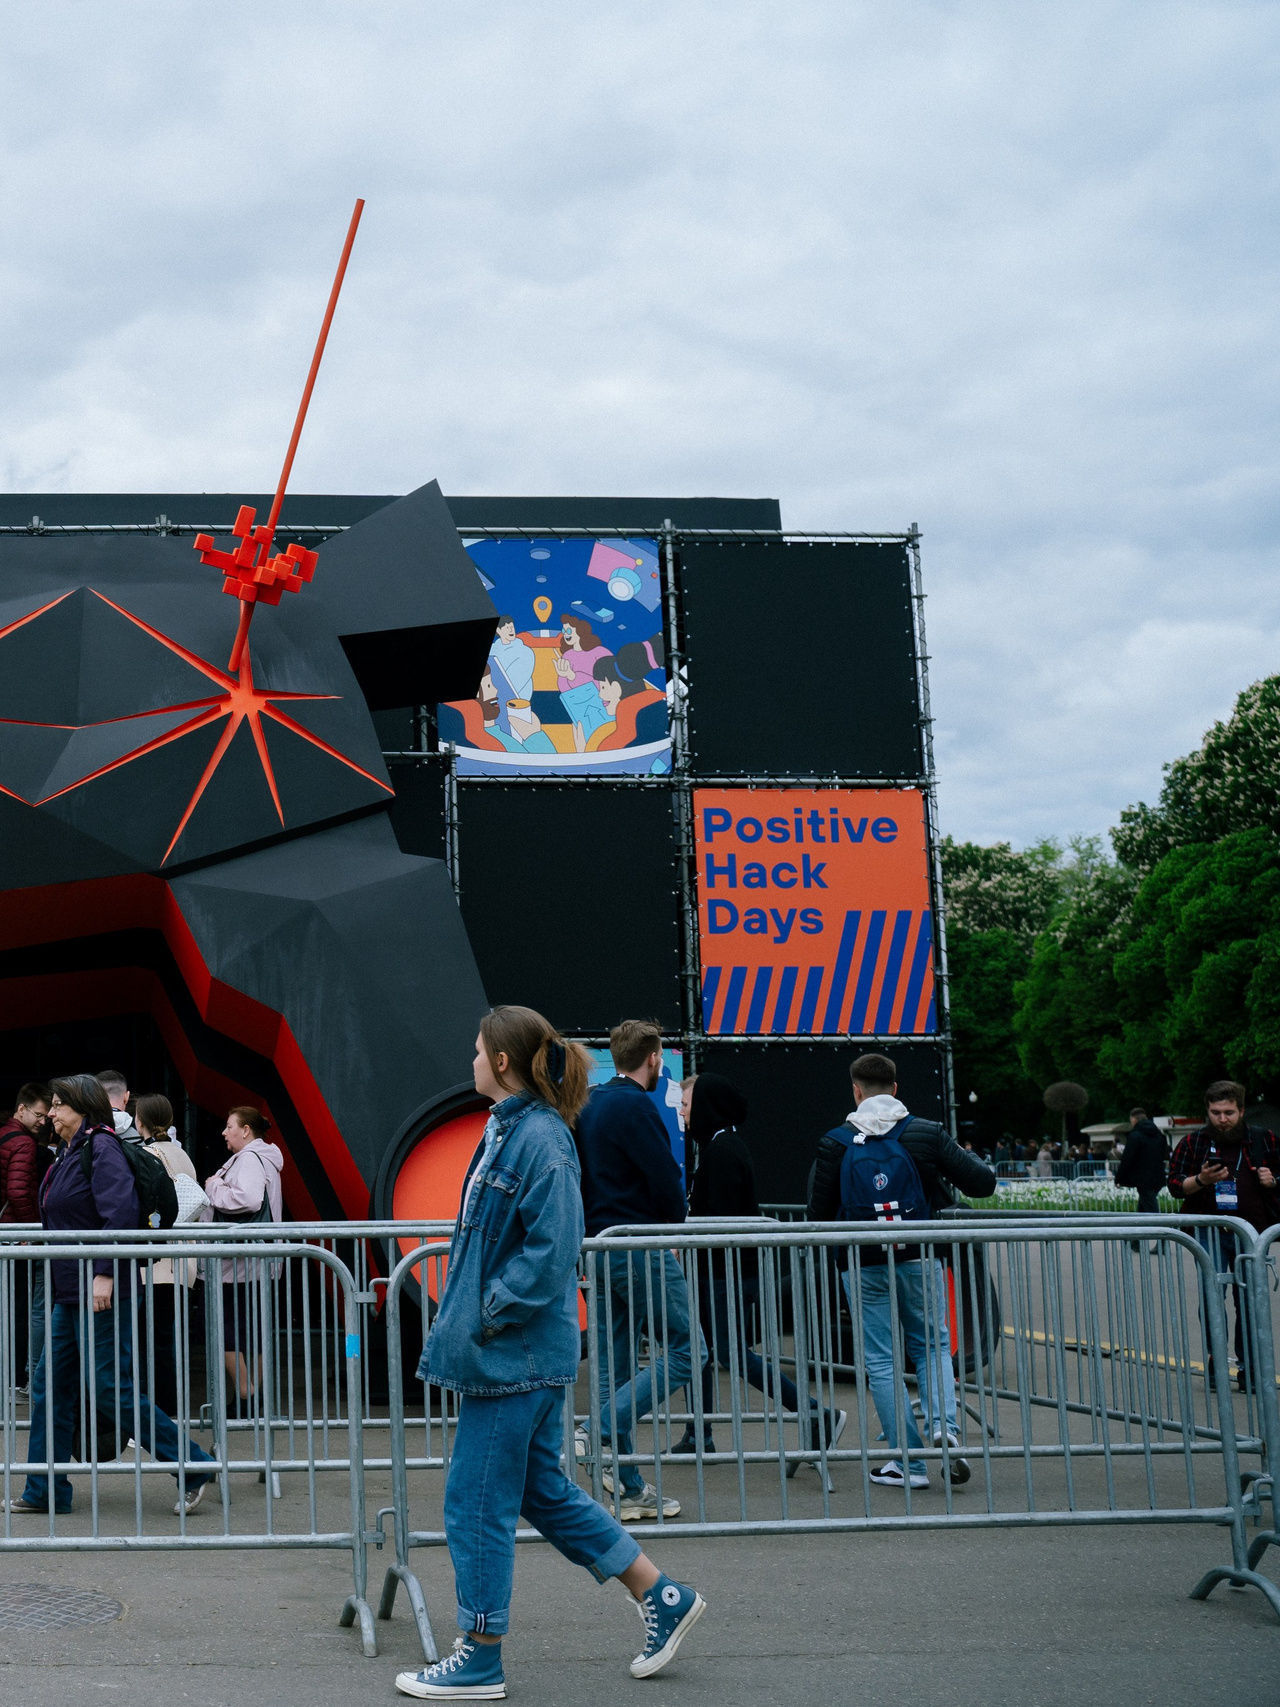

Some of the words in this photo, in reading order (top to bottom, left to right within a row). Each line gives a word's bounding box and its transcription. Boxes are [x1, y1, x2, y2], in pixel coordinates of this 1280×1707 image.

[703, 807, 898, 843] Positive
[705, 853, 829, 889] Hack
[707, 898, 824, 944] Days
